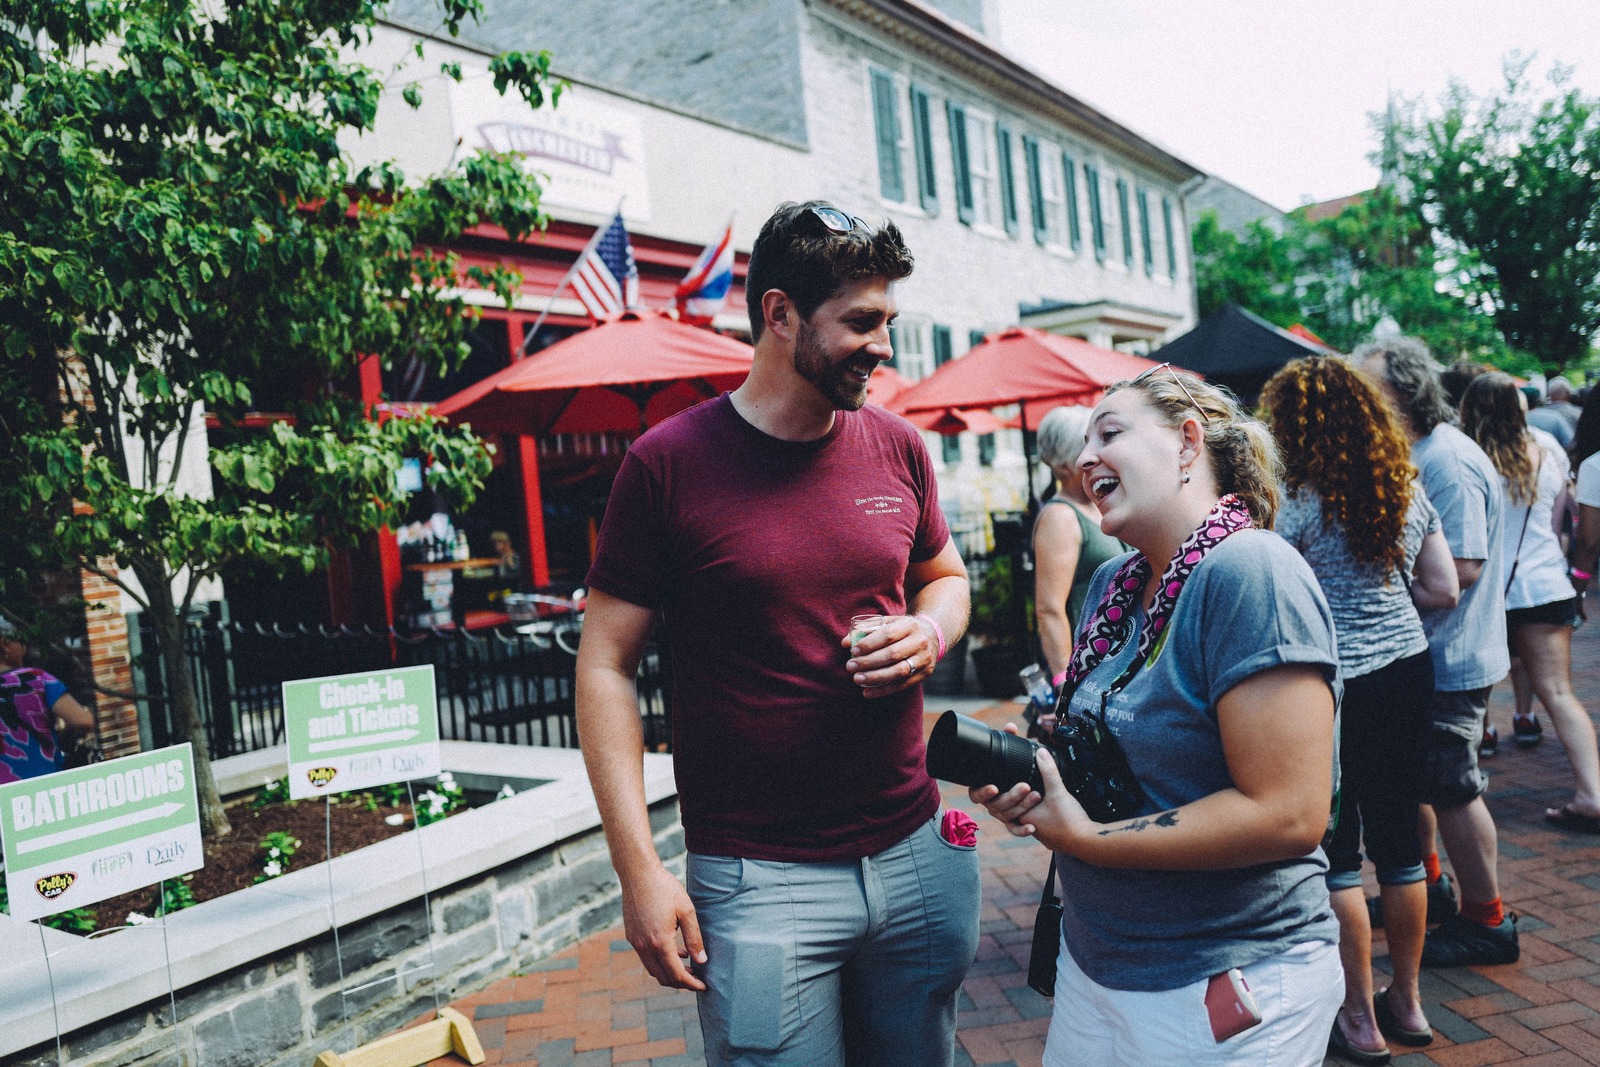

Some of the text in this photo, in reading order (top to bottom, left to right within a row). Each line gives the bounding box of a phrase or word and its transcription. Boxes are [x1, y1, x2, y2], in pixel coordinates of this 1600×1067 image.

[308, 703, 420, 739] and Tickets
[11, 759, 186, 832] BATHROOMS
[147, 841, 188, 865] Daily
[38, 873, 73, 893] Polly's
